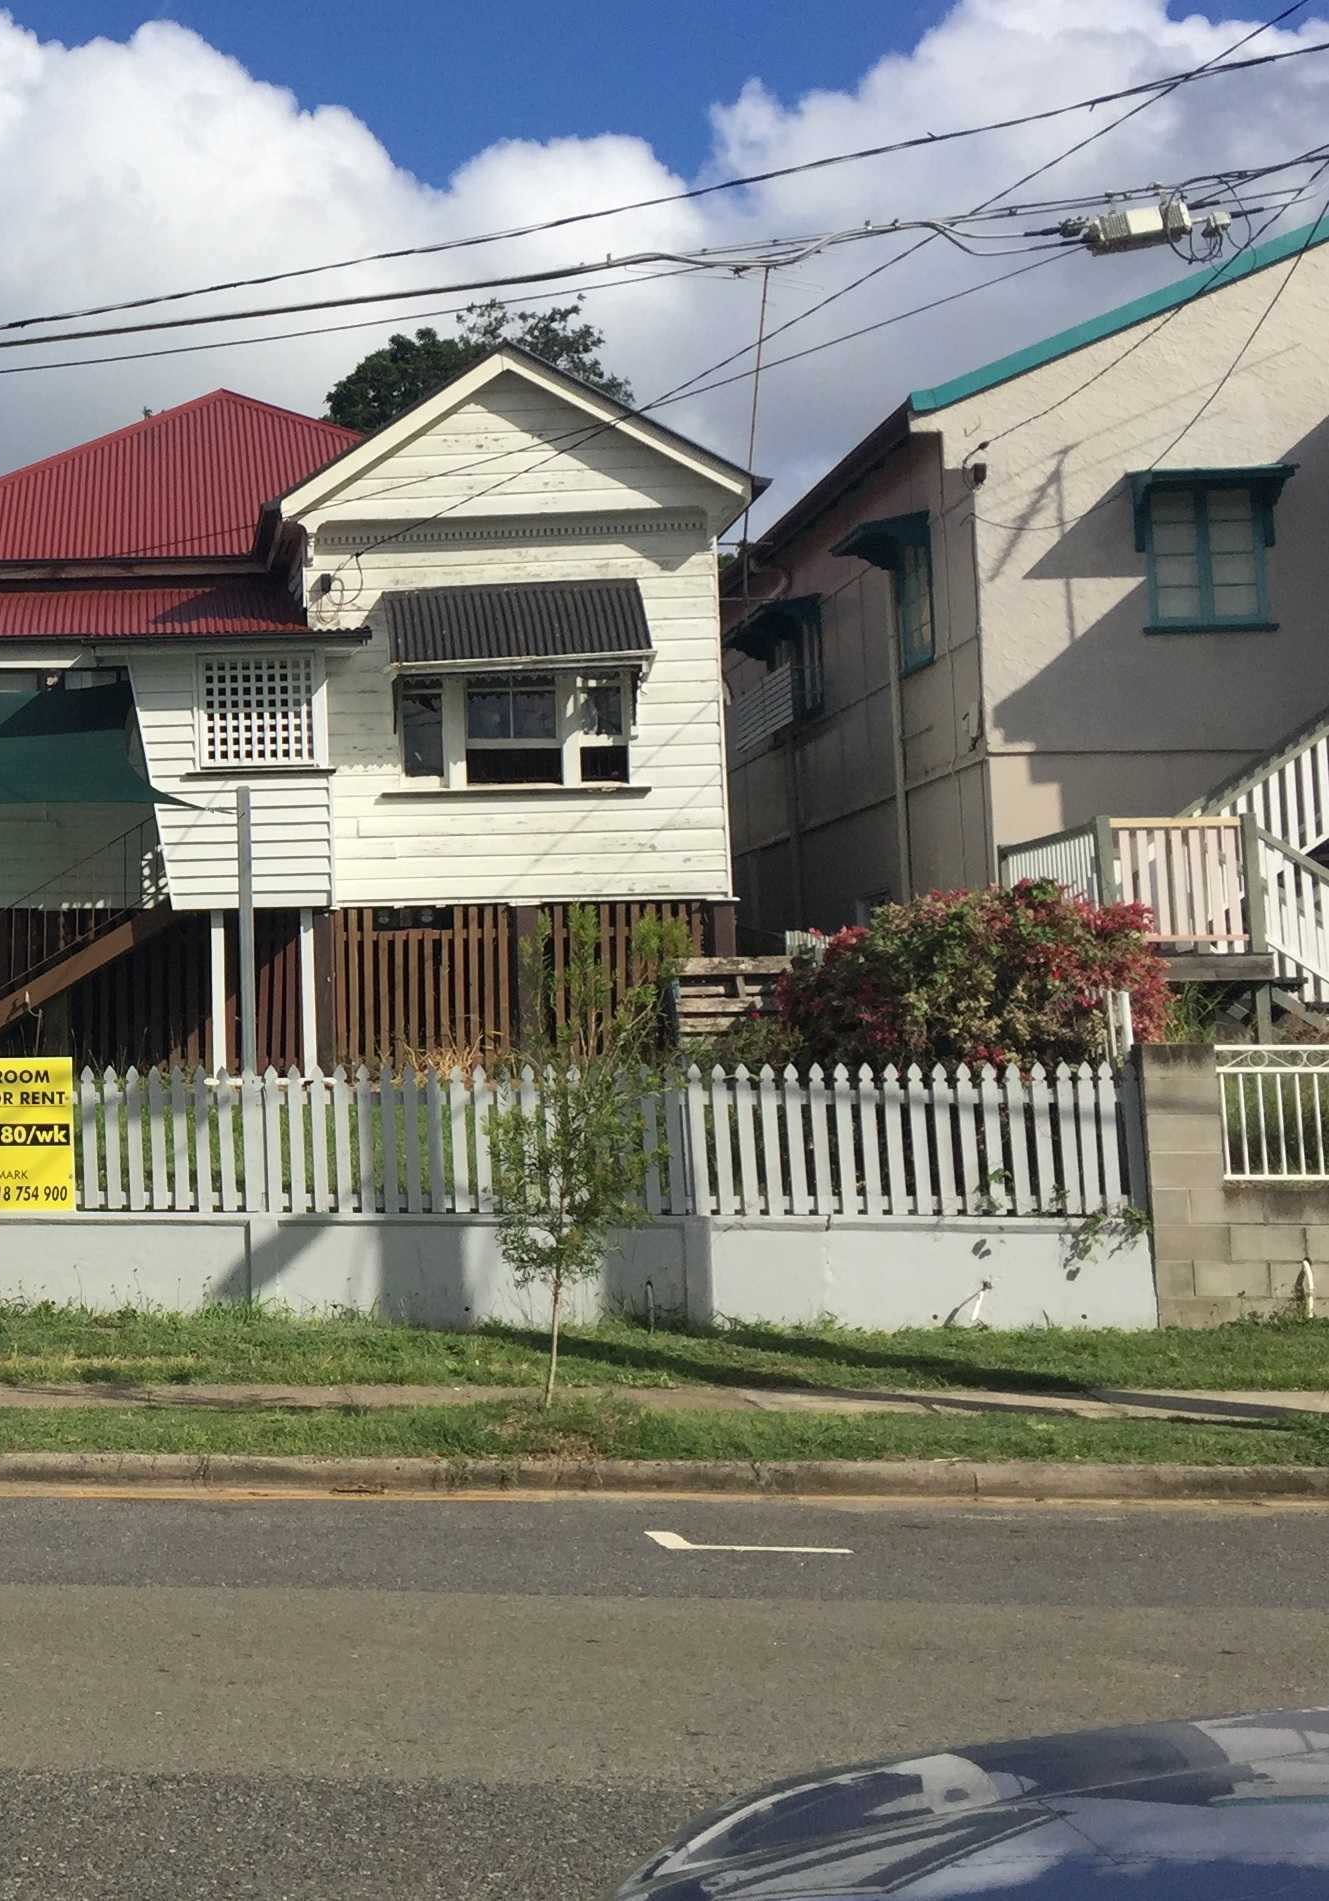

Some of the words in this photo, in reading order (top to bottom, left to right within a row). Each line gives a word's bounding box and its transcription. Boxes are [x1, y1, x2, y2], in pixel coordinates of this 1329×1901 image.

[19, 1091, 65, 1105] RENT
[16, 1185, 40, 1201] 754
[43, 1185, 68, 1201] 900
